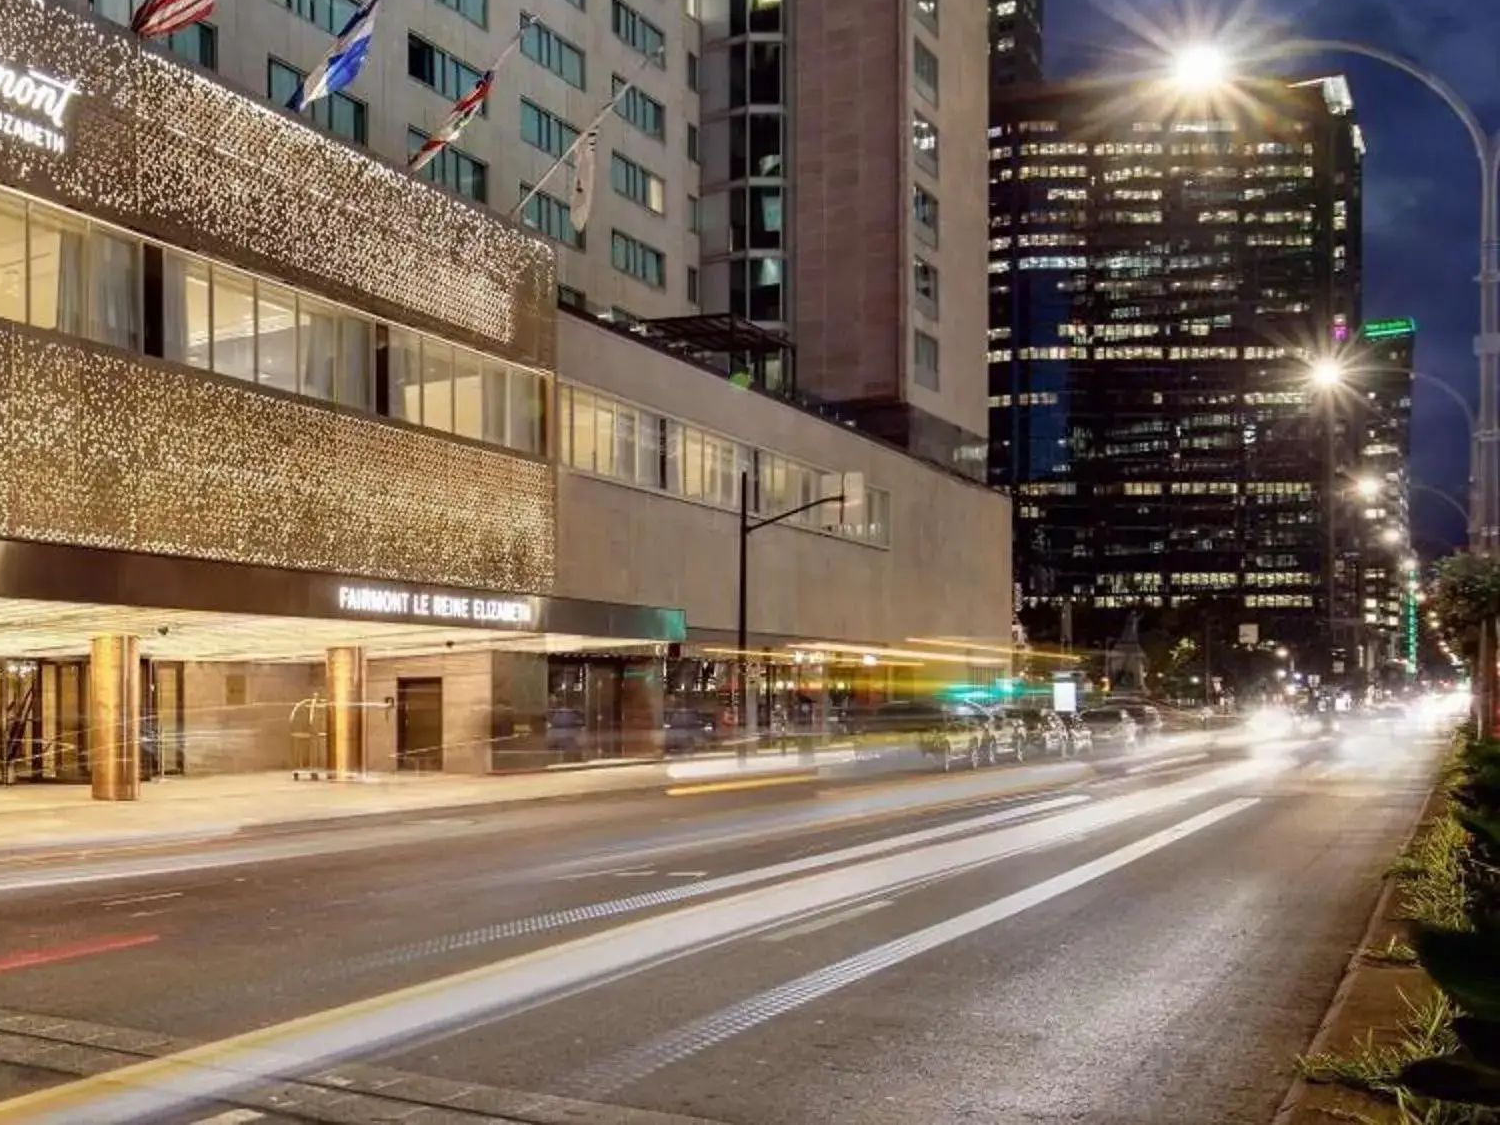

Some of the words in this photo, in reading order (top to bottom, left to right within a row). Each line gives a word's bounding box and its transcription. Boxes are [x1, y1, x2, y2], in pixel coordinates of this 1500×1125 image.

[339, 586, 409, 613] FAIRMONT
[413, 593, 430, 615] LE
[432, 595, 469, 618] REINE
[473, 598, 531, 622] ELIZABETH
